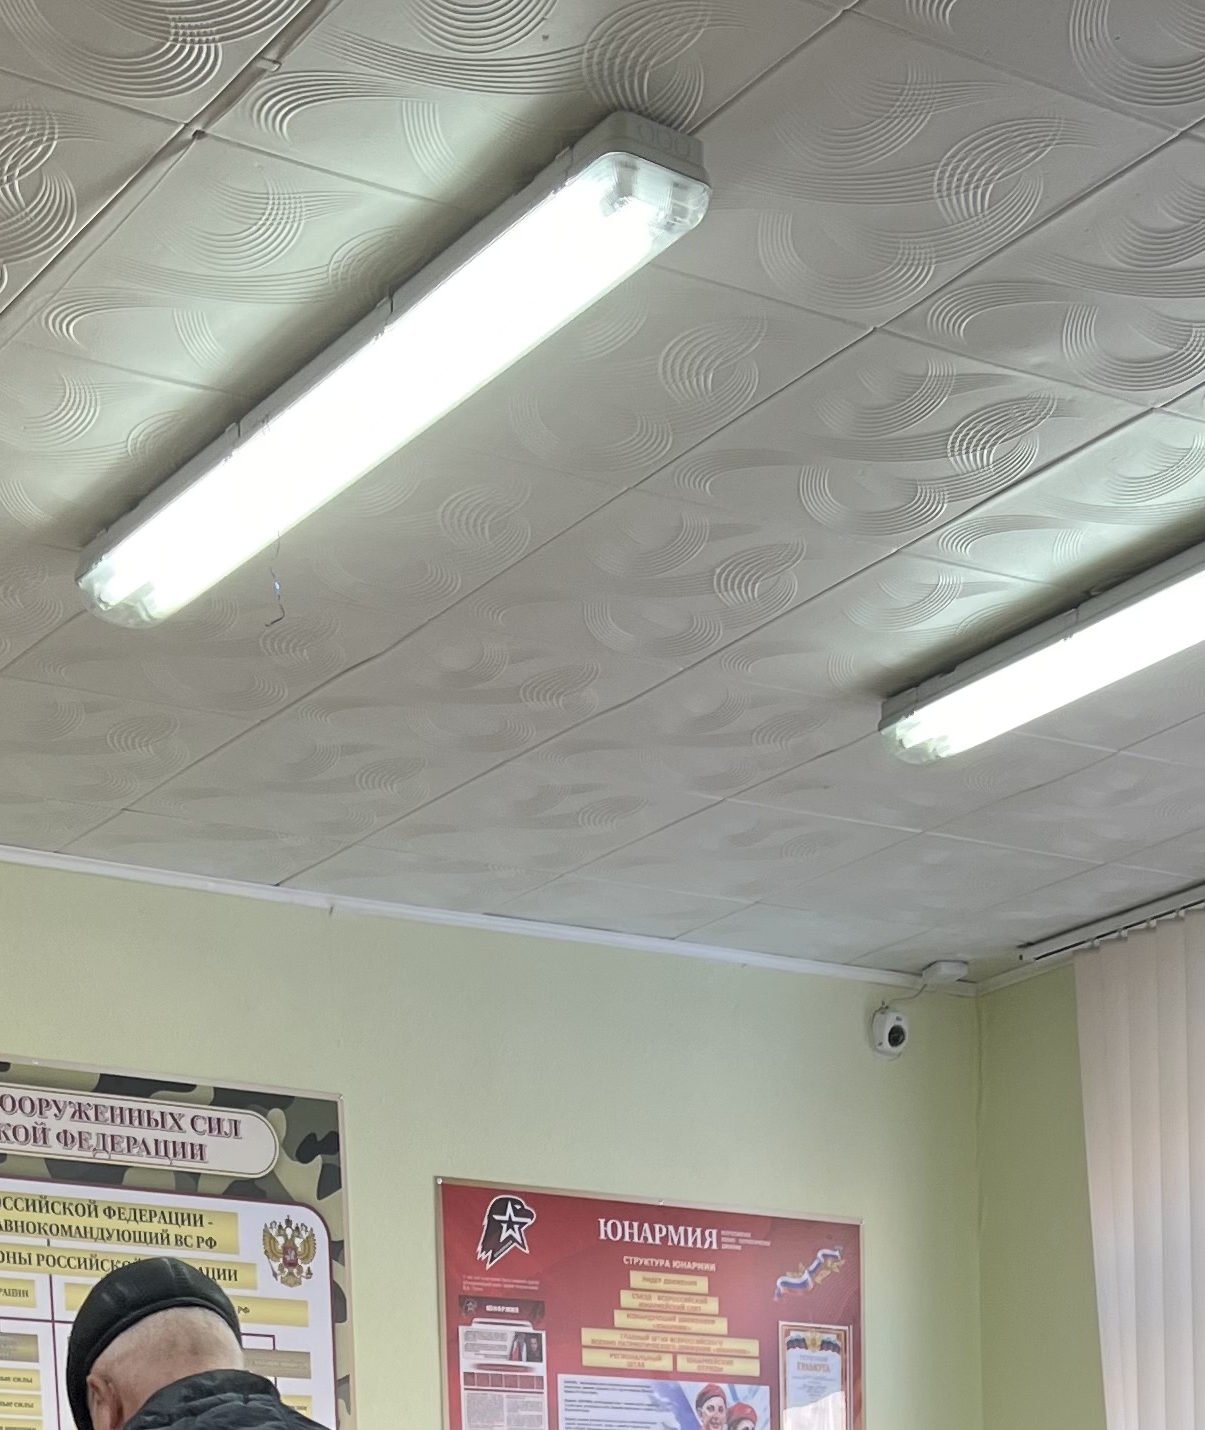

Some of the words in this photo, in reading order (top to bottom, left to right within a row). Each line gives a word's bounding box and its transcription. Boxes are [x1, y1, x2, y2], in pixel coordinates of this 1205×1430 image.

[190, 1114, 242, 1139] СИЛ
[56, 1129, 209, 1164] ФЕДЕРАЦИИ
[103, 1206, 204, 1228] ФЕДЕРАЦИИ
[174, 1234, 193, 1248] ВС
[196, 1236, 217, 1249] РФ
[598, 1218, 718, 1250] ЮНАРМИЯ
[36, 1253, 141, 1272] РОССИЙСК
[623, 1255, 670, 1268] СТРУКТУРА
[672, 1259, 716, 1271] ЮНАРМИИ
